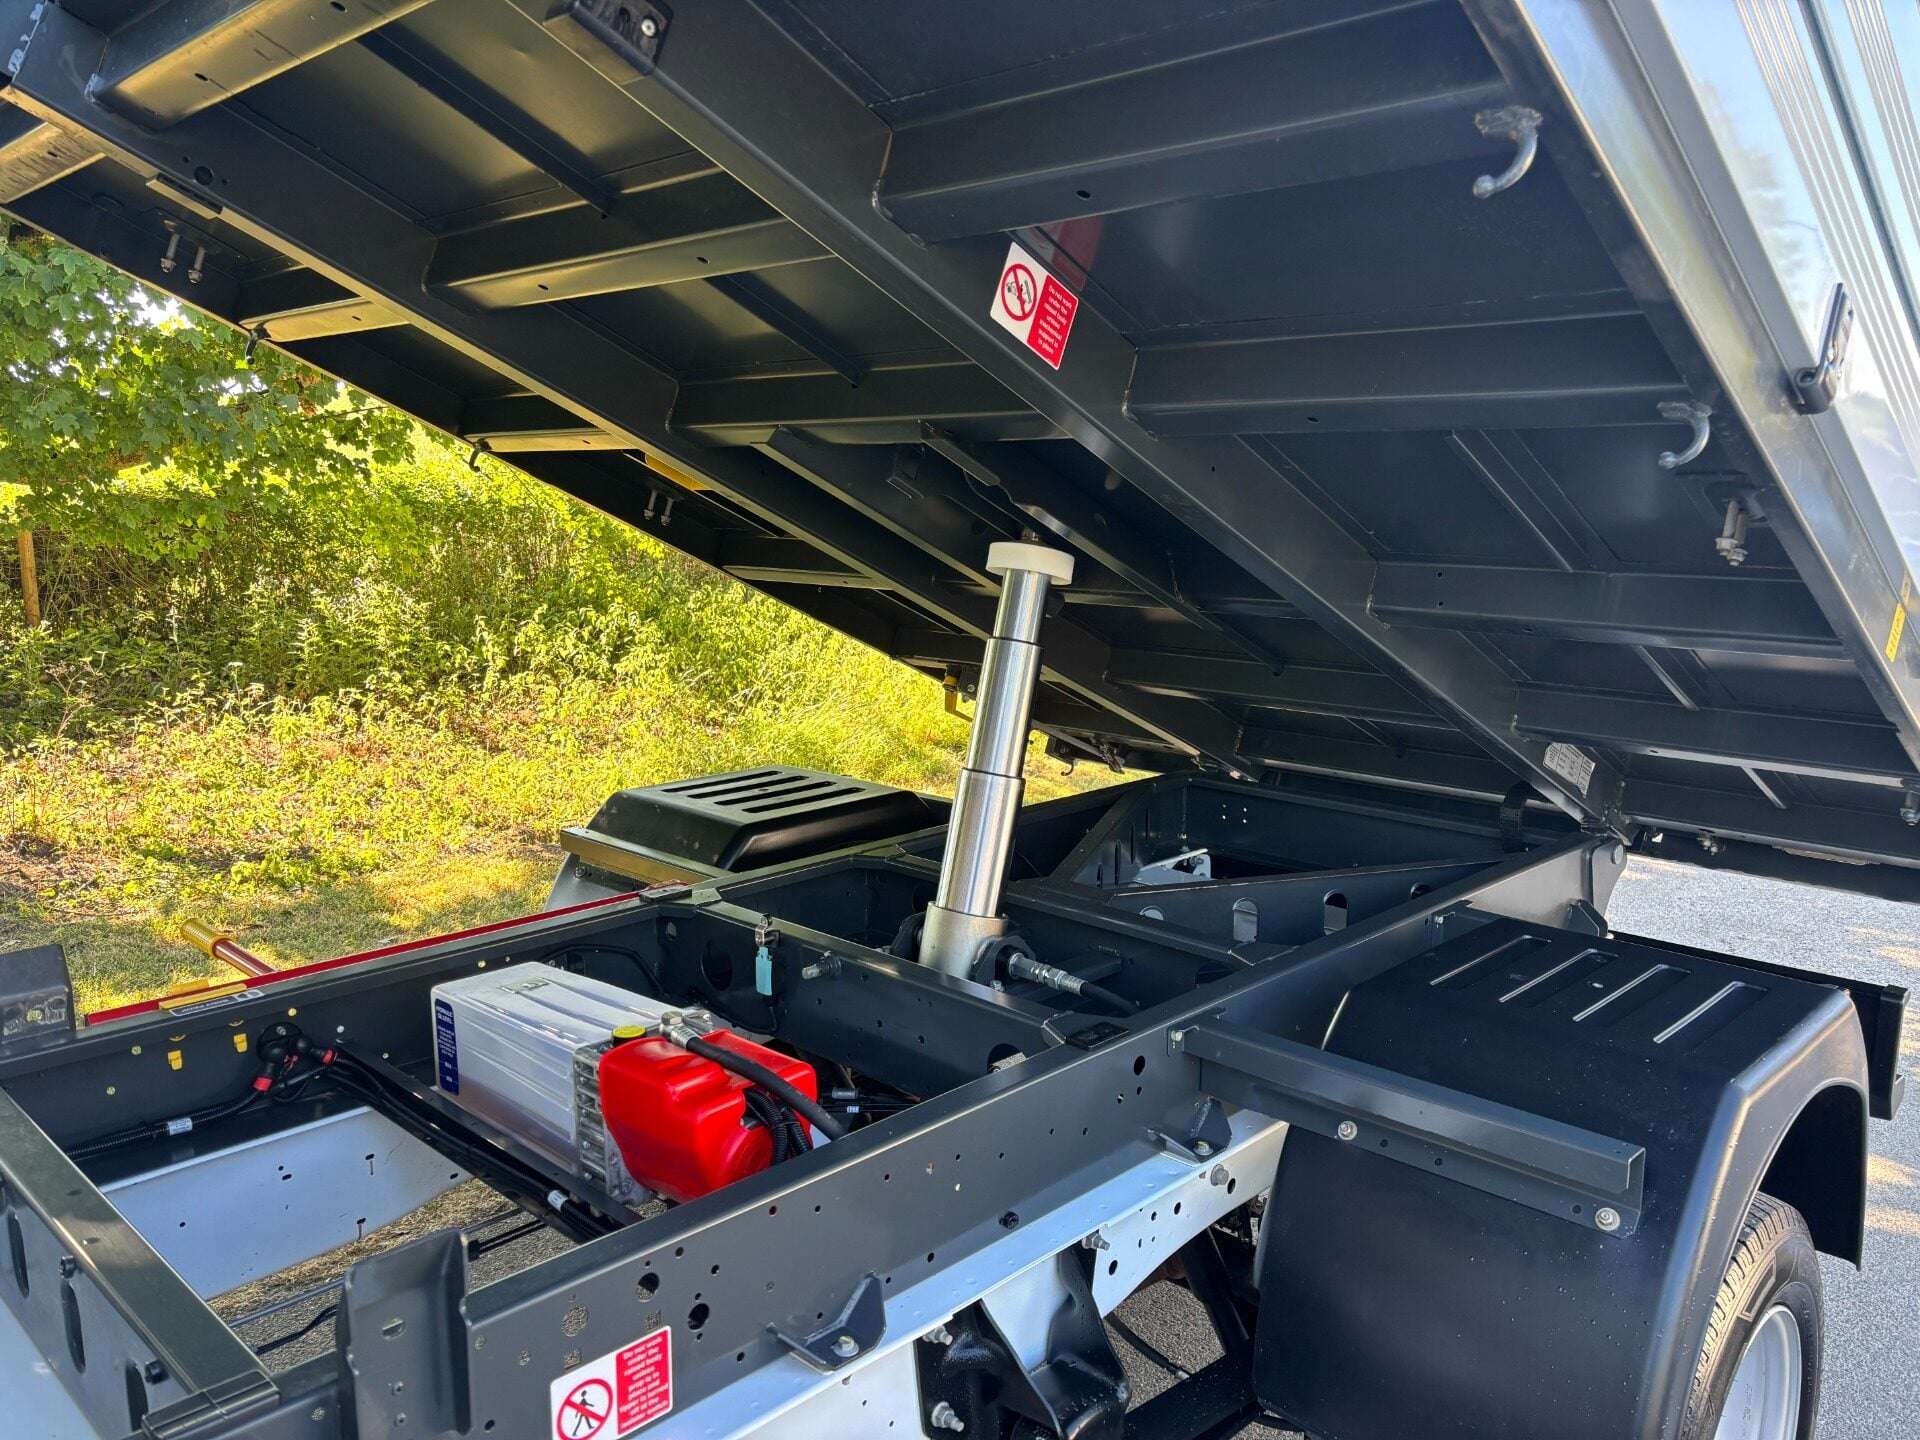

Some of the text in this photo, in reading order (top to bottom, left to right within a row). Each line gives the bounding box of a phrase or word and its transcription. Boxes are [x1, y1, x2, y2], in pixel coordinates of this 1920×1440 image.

[1062, 298, 1072, 309] work
[624, 1337, 662, 1360] Do not work
[627, 1346, 659, 1366] under the
[646, 1353, 662, 1365] body
